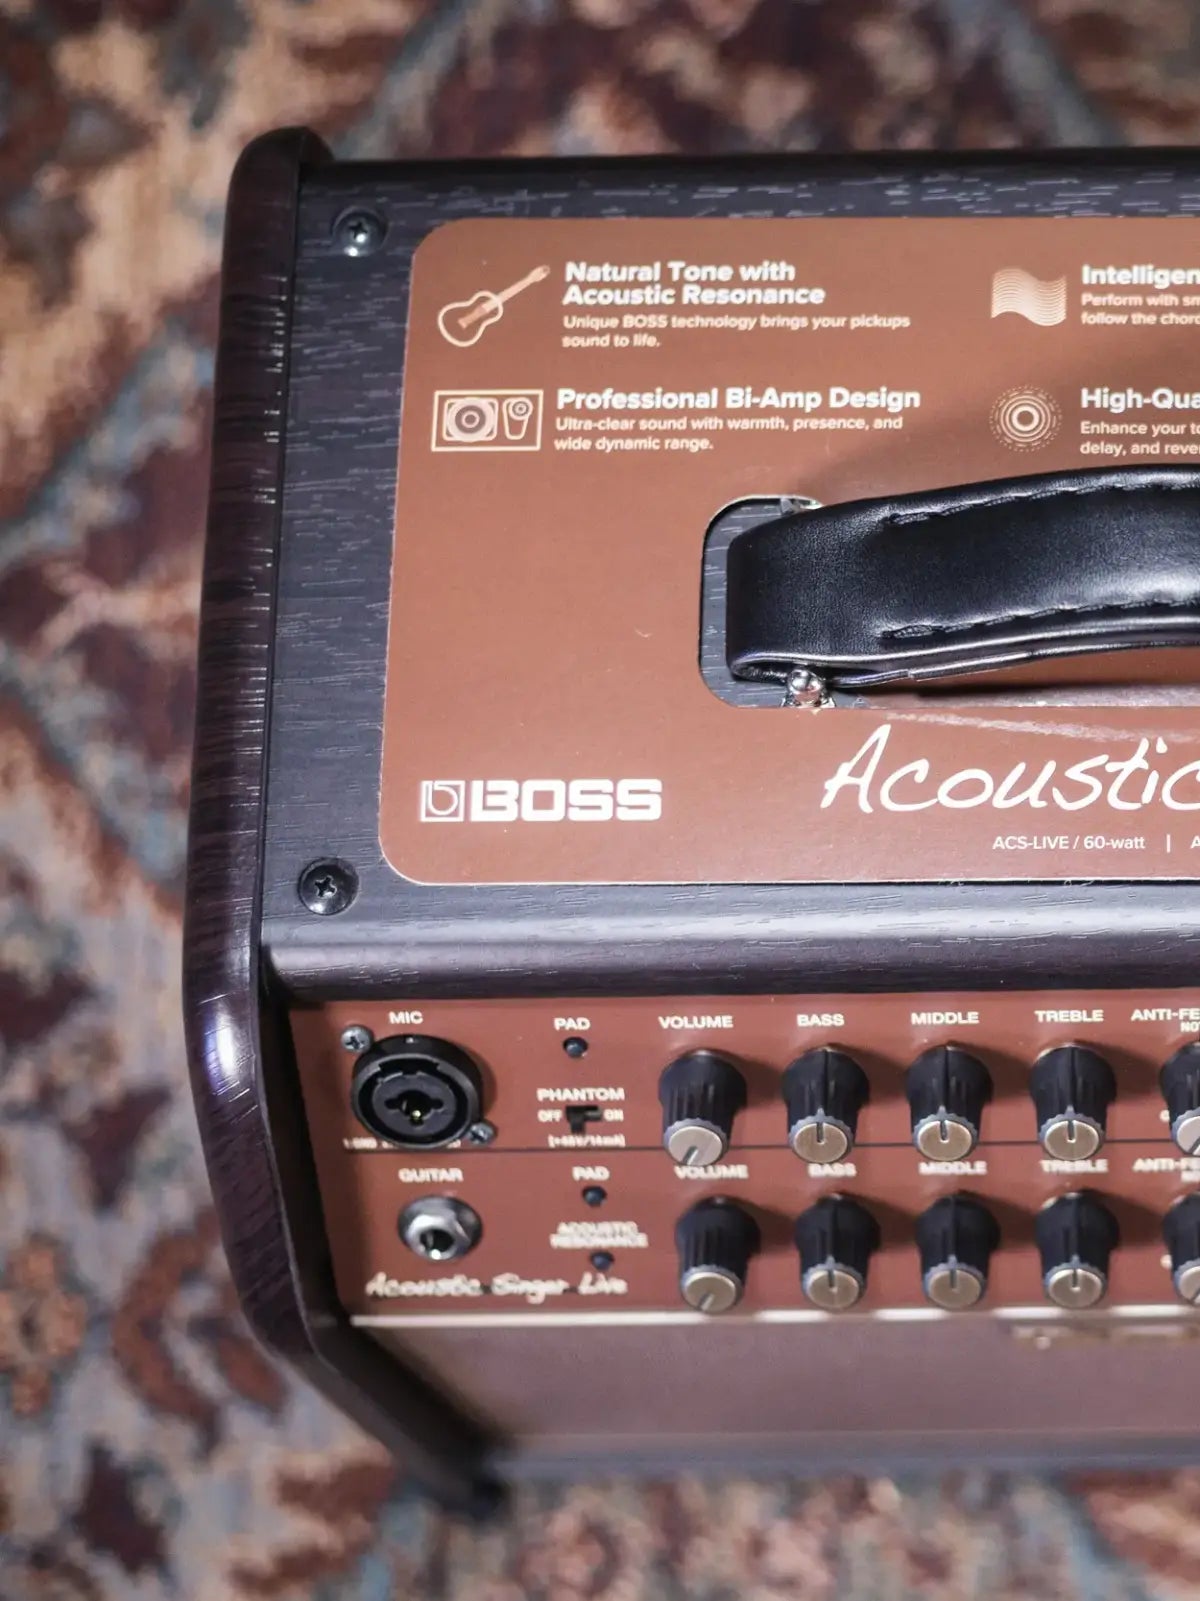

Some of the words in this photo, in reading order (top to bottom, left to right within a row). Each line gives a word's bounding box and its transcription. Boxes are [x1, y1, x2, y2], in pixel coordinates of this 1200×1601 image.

[566, 262, 660, 282] Natural
[668, 261, 733, 281] Tone
[740, 261, 795, 281] with
[563, 284, 675, 305] Acoustic
[682, 284, 825, 304] Resonance
[1082, 293, 1143, 305] Perform
[1146, 294, 1179, 306] with
[564, 316, 619, 330] Unique
[623, 314, 668, 328] BOSS
[671, 315, 757, 330] technology
[760, 315, 808, 330] brings
[812, 317, 847, 330] your
[850, 315, 910, 329] pickups
[1081, 312, 1128, 324] follow
[1131, 313, 1157, 324] the
[562, 334, 610, 347] sound
[614, 335, 630, 347] to
[633, 334, 660, 346] life.
[558, 388, 718, 409] Professional
[726, 387, 822, 412] Bi-Amp
[829, 387, 920, 412] Design
[556, 417, 635, 430] Ultra-clear
[639, 417, 687, 430] sound
[691, 417, 723, 429] with
[727, 417, 789, 430] warmth,
[793, 418, 869, 431] presence,
[873, 417, 903, 429] and
[1081, 421, 1147, 434] Enhance
[1152, 424, 1186, 437] your
[554, 437, 592, 450] wide
[595, 437, 660, 452] dynamic
[665, 439, 713, 452] range.
[1080, 441, 1126, 456] delay,
[1131, 442, 1160, 454] and
[470, 779, 662, 821] BOSS
[992, 836, 1069, 849] ACS-LIVE
[1084, 836, 1145, 849] 60-watt
[389, 1011, 423, 1024] MIC
[659, 1016, 733, 1029] VOLUME
[797, 1014, 844, 1027] BASS
[911, 1012, 979, 1025] MIDDLE
[1035, 1010, 1103, 1022] TREBLE
[554, 1017, 590, 1030] PAD
[537, 1088, 625, 1101] PHANTOM
[538, 1110, 562, 1122] OFF
[399, 1168, 463, 1182] GUITAR
[573, 1166, 609, 1180] PAD
